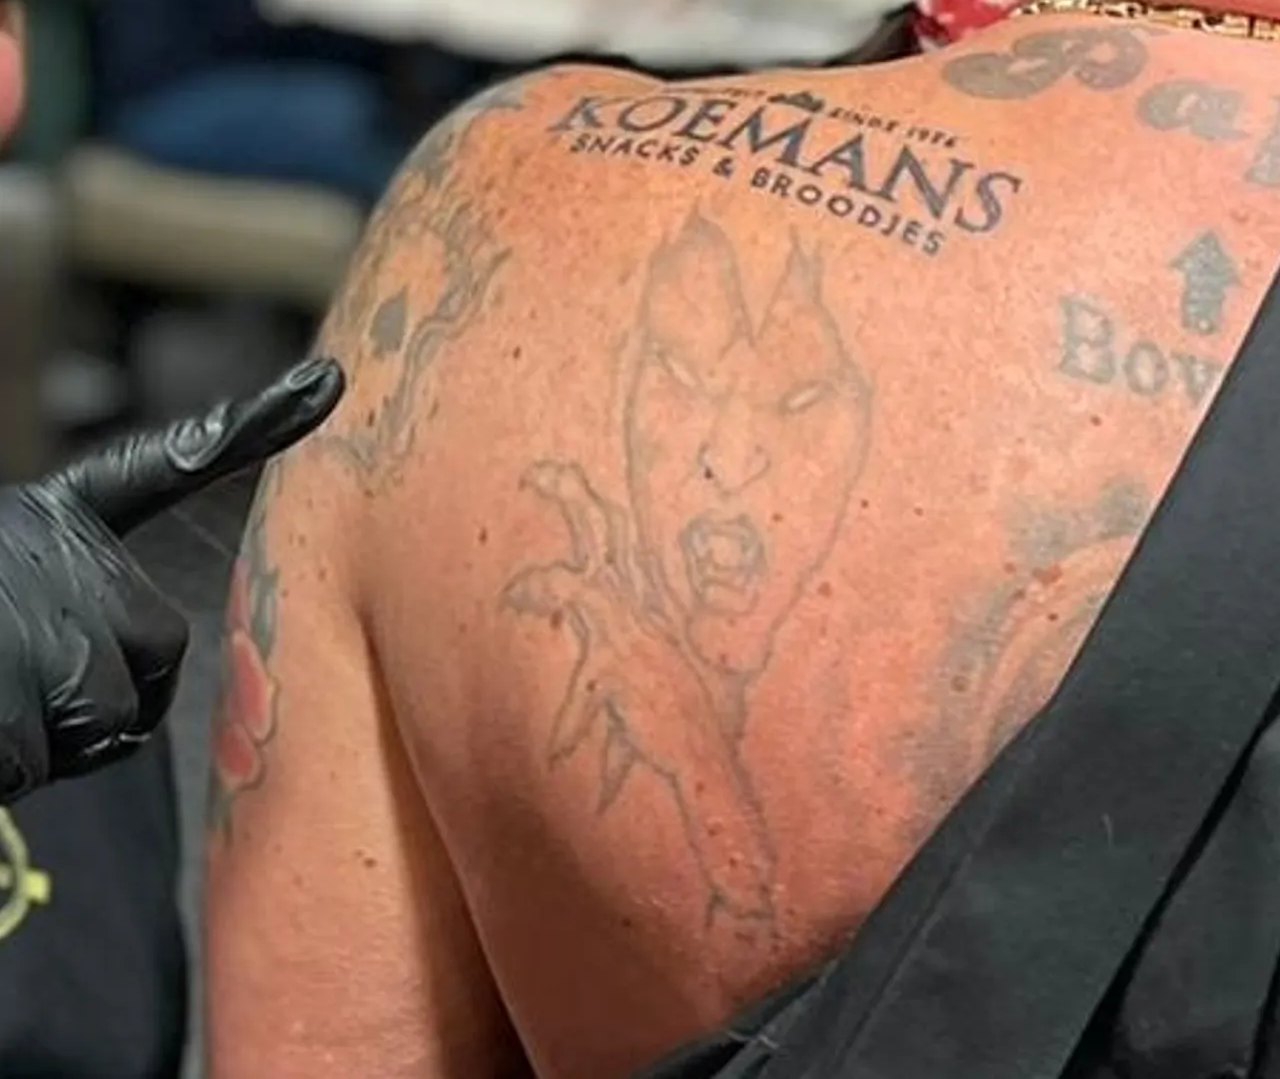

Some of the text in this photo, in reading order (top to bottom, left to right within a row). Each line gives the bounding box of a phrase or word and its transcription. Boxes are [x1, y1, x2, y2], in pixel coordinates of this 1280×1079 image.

[549, 95, 1022, 234] KOEMANS
[570, 131, 946, 256] SNACKS & BROODJES
